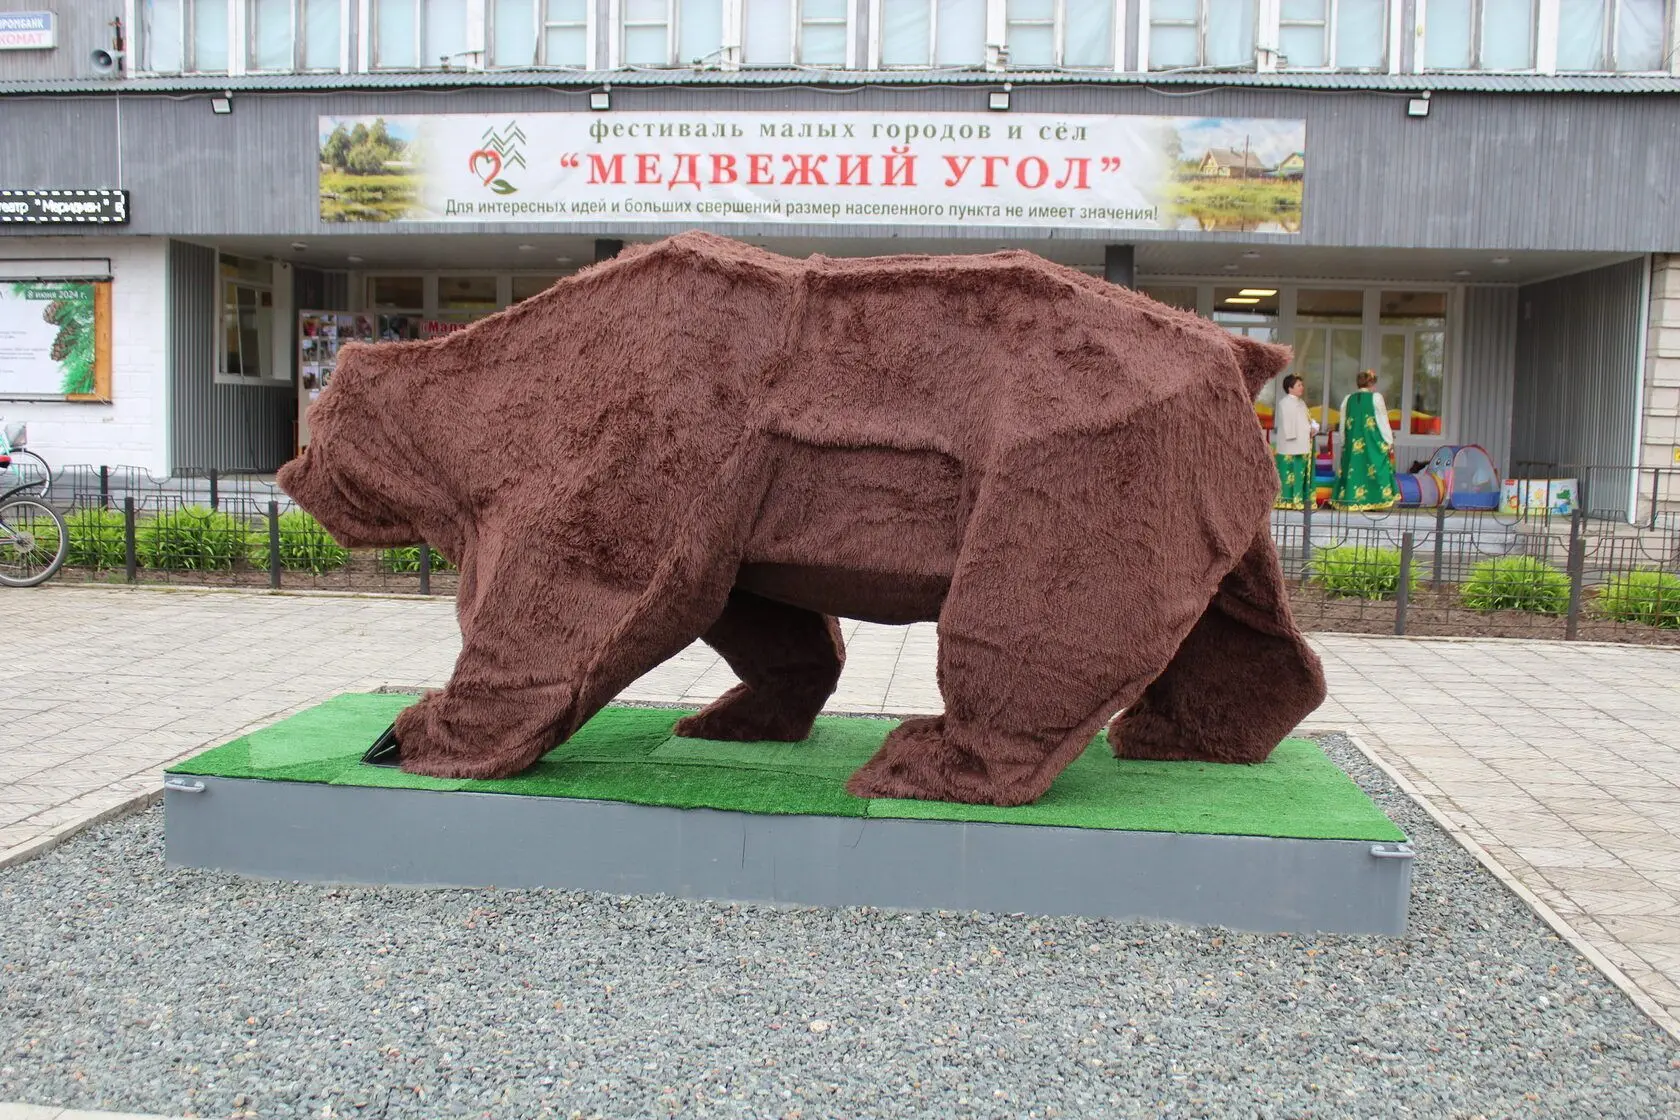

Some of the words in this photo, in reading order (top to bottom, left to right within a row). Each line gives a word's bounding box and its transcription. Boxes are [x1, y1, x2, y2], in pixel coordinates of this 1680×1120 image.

[588, 117, 744, 145] фестиваль
[759, 122, 855, 138] малых
[871, 123, 992, 145] городов
[1007, 124, 1022, 140] и
[1038, 121, 1087, 141] сёл
[560, 142, 918, 192] “МЕДВЕЖИЙ
[941, 155, 1121, 190] УГОЛ”
[445, 198, 474, 217] Для
[478, 201, 568, 217] интересных
[570, 198, 607, 216] идей
[612, 201, 620, 213] и
[624, 197, 692, 214] больших
[695, 198, 782, 217] свершений
[785, 202, 841, 218] размер
[845, 203, 944, 216] населенного
[948, 204, 1001, 219] пункта
[1005, 205, 1024, 218] не
[1028, 205, 1076, 219] имеет
[1079, 205, 1158, 221] значения!
